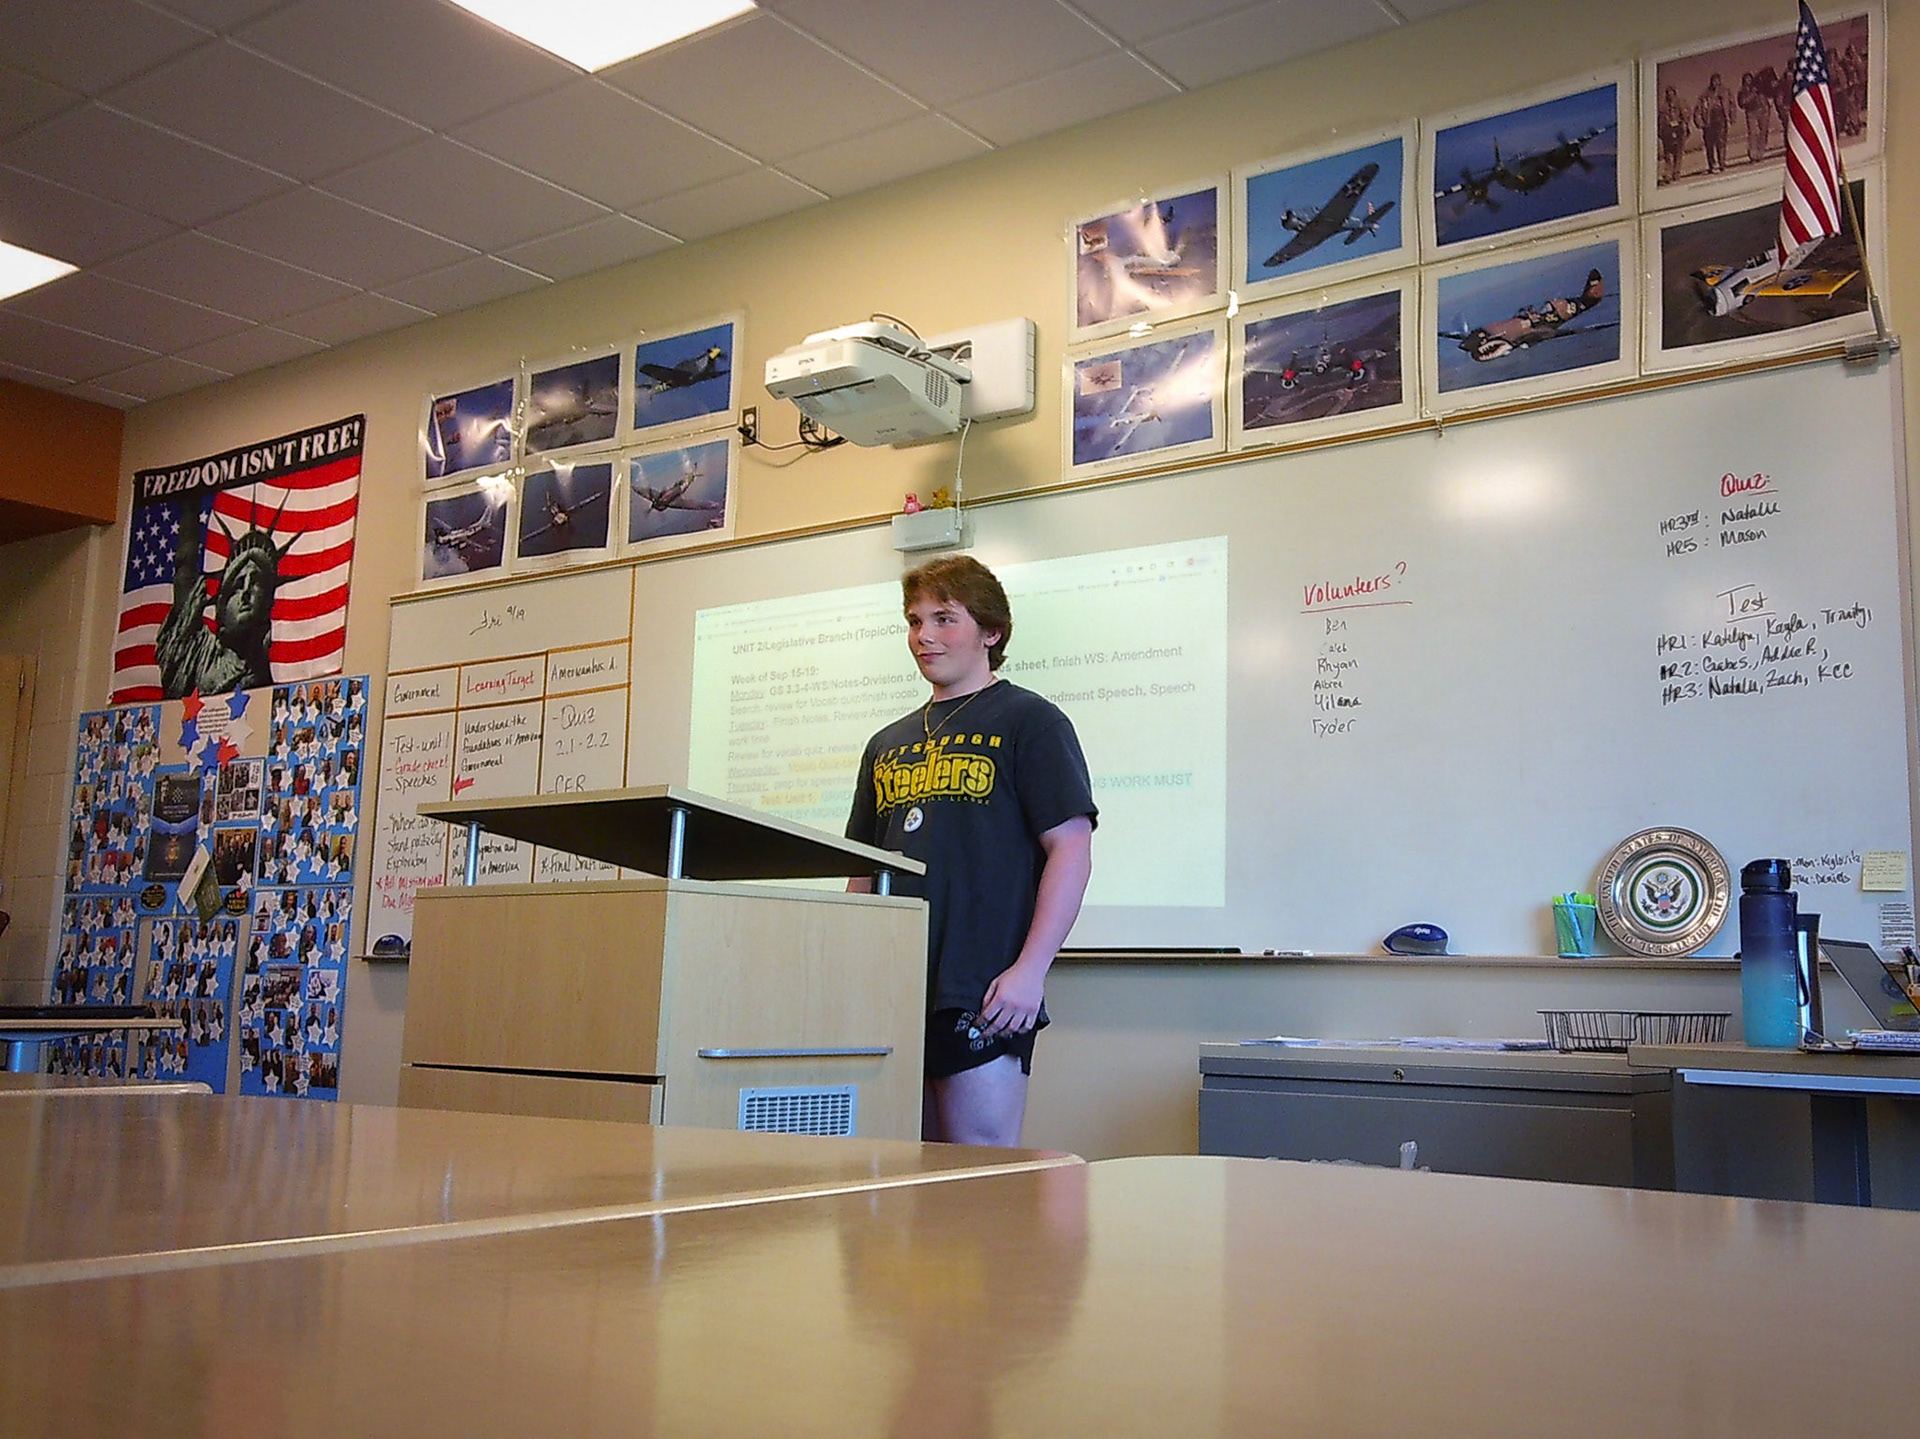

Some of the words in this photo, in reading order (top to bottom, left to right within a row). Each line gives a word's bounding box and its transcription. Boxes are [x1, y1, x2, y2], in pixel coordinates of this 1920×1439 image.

[143, 457, 237, 498] FREEDOM
[241, 441, 297, 479] ISN'T
[299, 419, 361, 462] FREE!
[1720, 529, 1767, 548] Mason
[1716, 584, 1768, 616] Test
[732, 643, 755, 655] UNIT
[818, 630, 853, 645] Branch
[855, 624, 909, 642] (Topic/Cha
[1111, 646, 1183, 663] Amendment
[466, 674, 506, 695] Learning
[506, 669, 534, 692] Target
[906, 671, 917, 682] of
[1045, 690, 1094, 703] endment
[1150, 681, 1196, 697] Speech
[1110, 774, 1151, 789] WORK
[1154, 772, 1192, 787] MUST
[1602, 859, 1620, 899] UNITED
